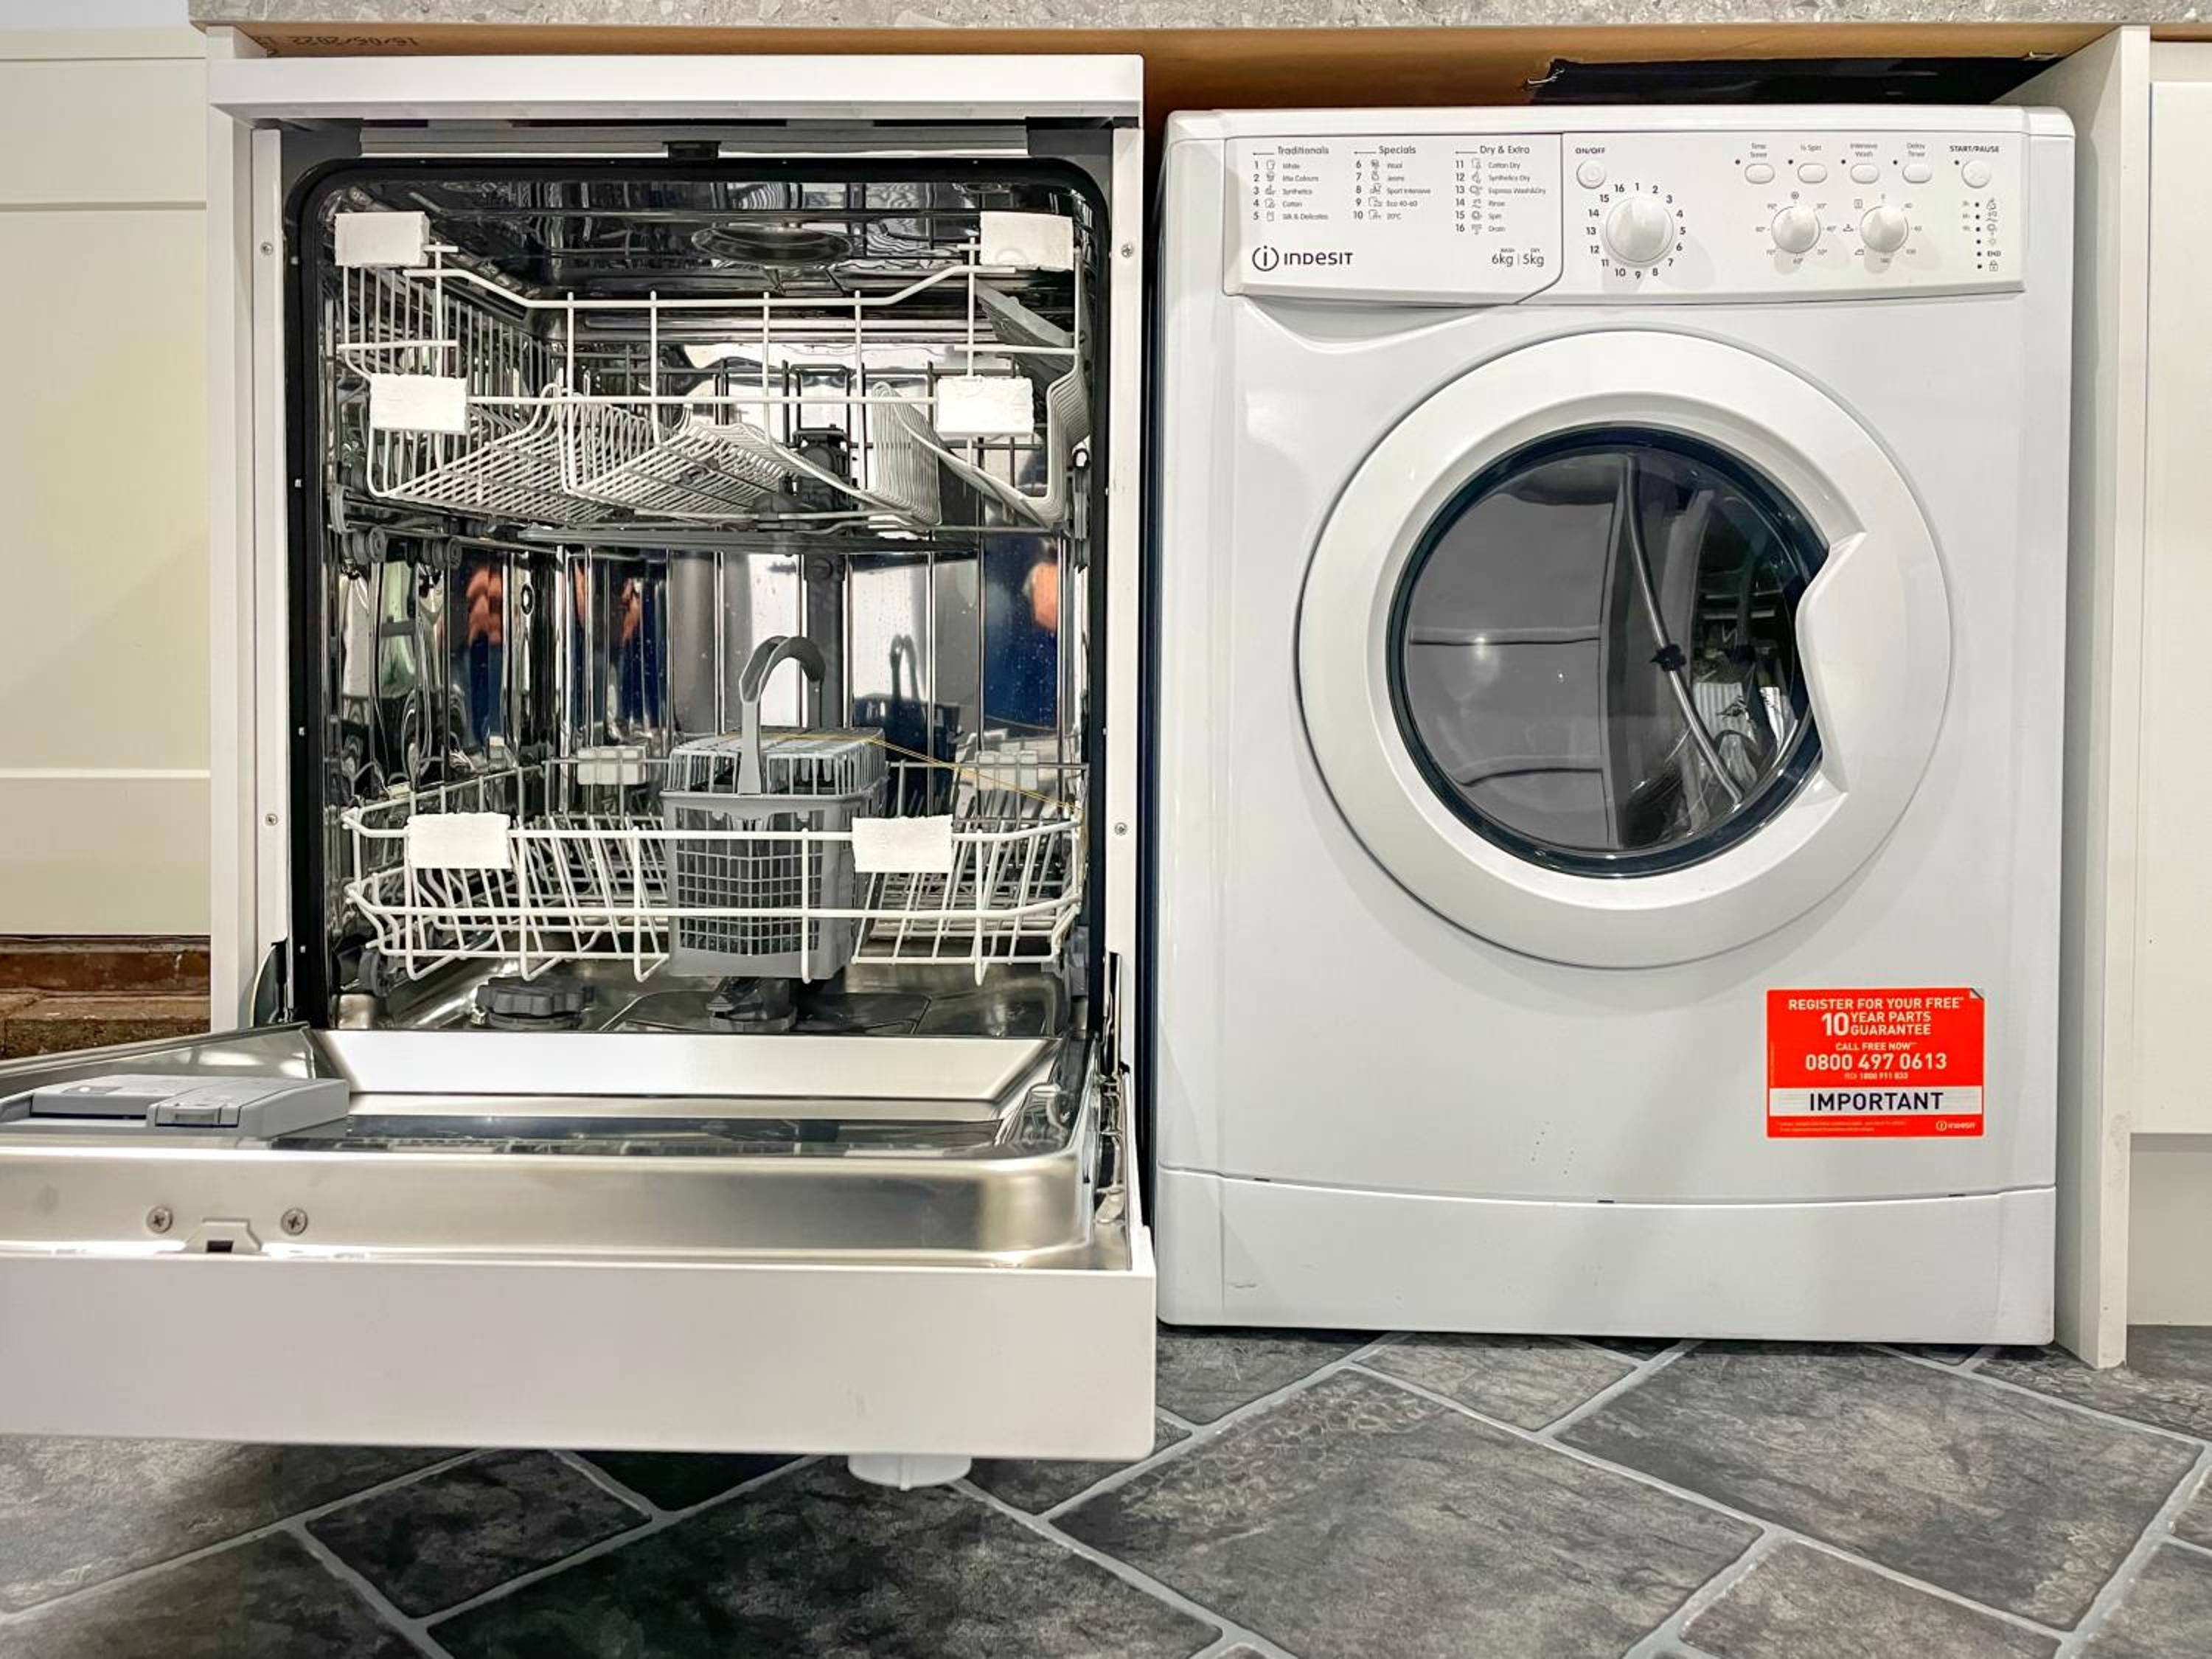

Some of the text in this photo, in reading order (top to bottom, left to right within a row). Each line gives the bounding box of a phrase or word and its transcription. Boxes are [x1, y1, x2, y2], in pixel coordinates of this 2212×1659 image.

[1278, 146, 1329, 154] Traditionals
[1379, 145, 1416, 156] Specials
[1480, 145, 1530, 156] Dry & Extra
[1254, 160, 1259, 169] 1
[1356, 160, 1362, 169] 6
[1455, 160, 1464, 169] 11
[1509, 162, 1520, 170] Dry
[1253, 173, 1260, 182] 2
[1356, 173, 1362, 181] 7
[1455, 173, 1465, 181] 12
[1253, 186, 1259, 195] 3
[1356, 185, 1362, 194] 8
[1455, 186, 1465, 194] 13
[1615, 184, 1624, 192] 16
[1635, 183, 1639, 191] 1
[1652, 186, 1658, 194] 2
[1253, 199, 1259, 207] 4
[1356, 198, 1362, 206] 9
[1455, 198, 1465, 206] 14
[1599, 195, 1610, 203] 15
[1666, 195, 1672, 204] 3
[1253, 211, 1259, 220] 5
[1353, 210, 1363, 220] 10
[1455, 211, 1465, 219] 15
[1455, 224, 1465, 232] 16
[1587, 227, 1596, 235] 13
[1590, 246, 1599, 254] 12
[1677, 243, 1683, 251] 6
[1284, 251, 1353, 265] INDESIT
[1492, 254, 1545, 268] 6kg 5kg
[1668, 259, 1674, 267] 7
[1615, 268, 1626, 276] 10
[1635, 271, 1641, 279] 9
[1652, 268, 1658, 276] 8
[1789, 998, 1853, 1011] REGISTER
[1857, 998, 1882, 1009] FOR
[1887, 997, 1921, 1009] YOUR
[1821, 1012, 1931, 1036] 10 YEAR PARTS
[1851, 1023, 1931, 1035] GUARANTEE
[1836, 1042, 1860, 1051] CALL
[1862, 1042, 1886, 1051] FREE
[1806, 1053, 1947, 1071] 0800 497 0613
[1809, 1092, 1944, 1111] IMPORTANT
